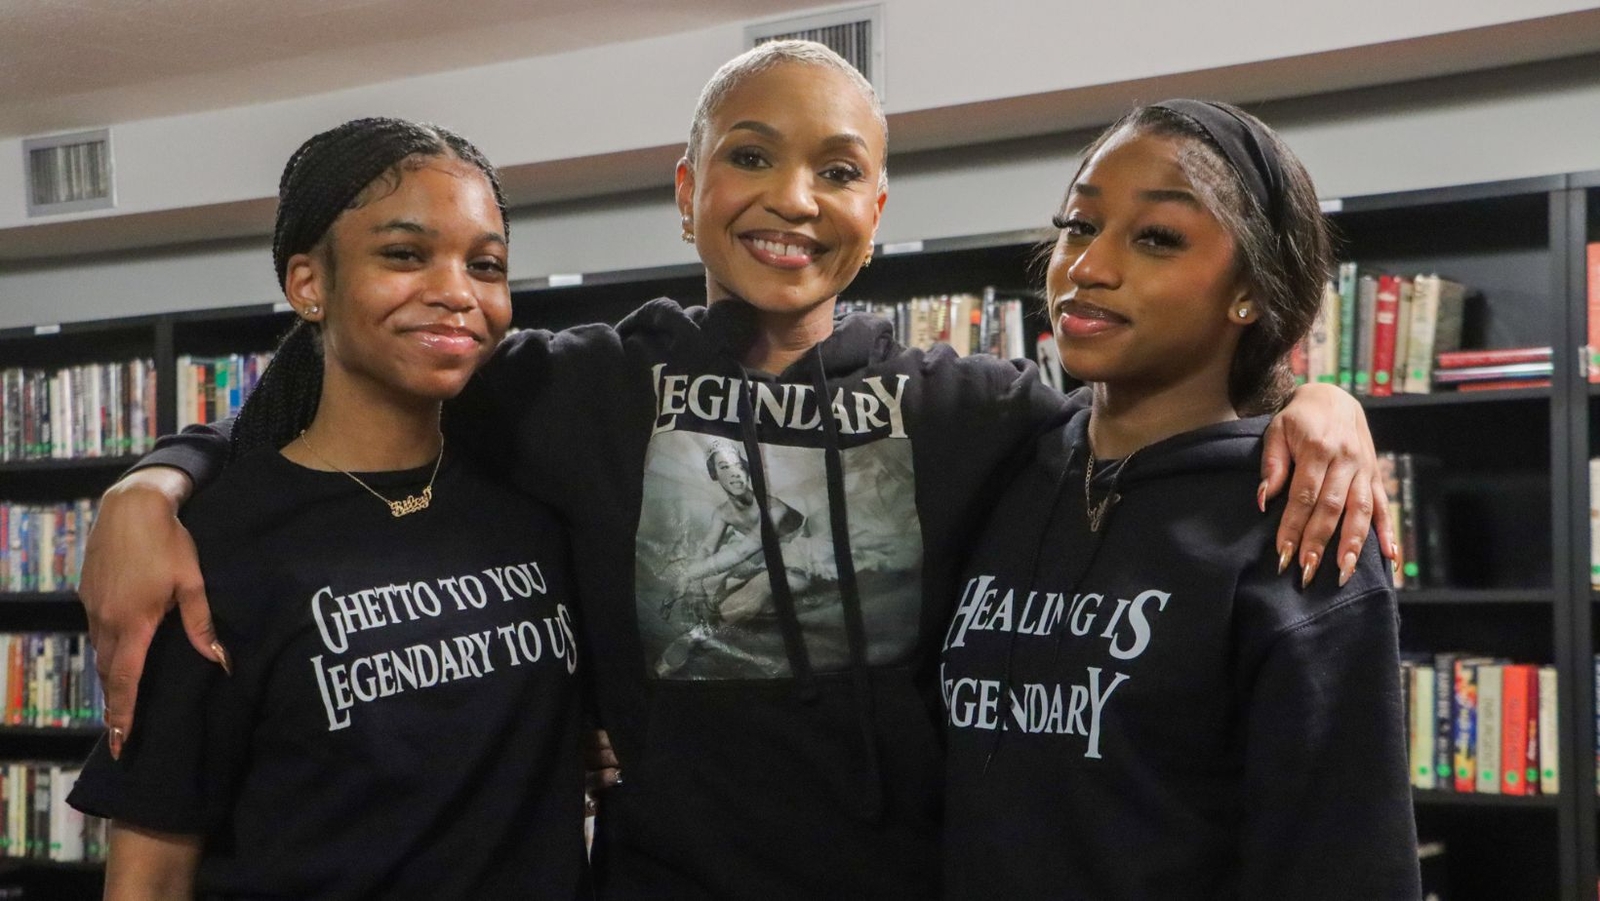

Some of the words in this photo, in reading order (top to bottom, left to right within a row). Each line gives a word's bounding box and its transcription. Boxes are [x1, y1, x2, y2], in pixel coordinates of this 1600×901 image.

[311, 586, 442, 654] GHETTO
[437, 575, 487, 611] TO
[482, 562, 547, 601] YOU
[1100, 589, 1172, 660] IS
[310, 630, 495, 731] LEGENDARY
[497, 621, 542, 666] TO
[543, 603, 577, 675] US
